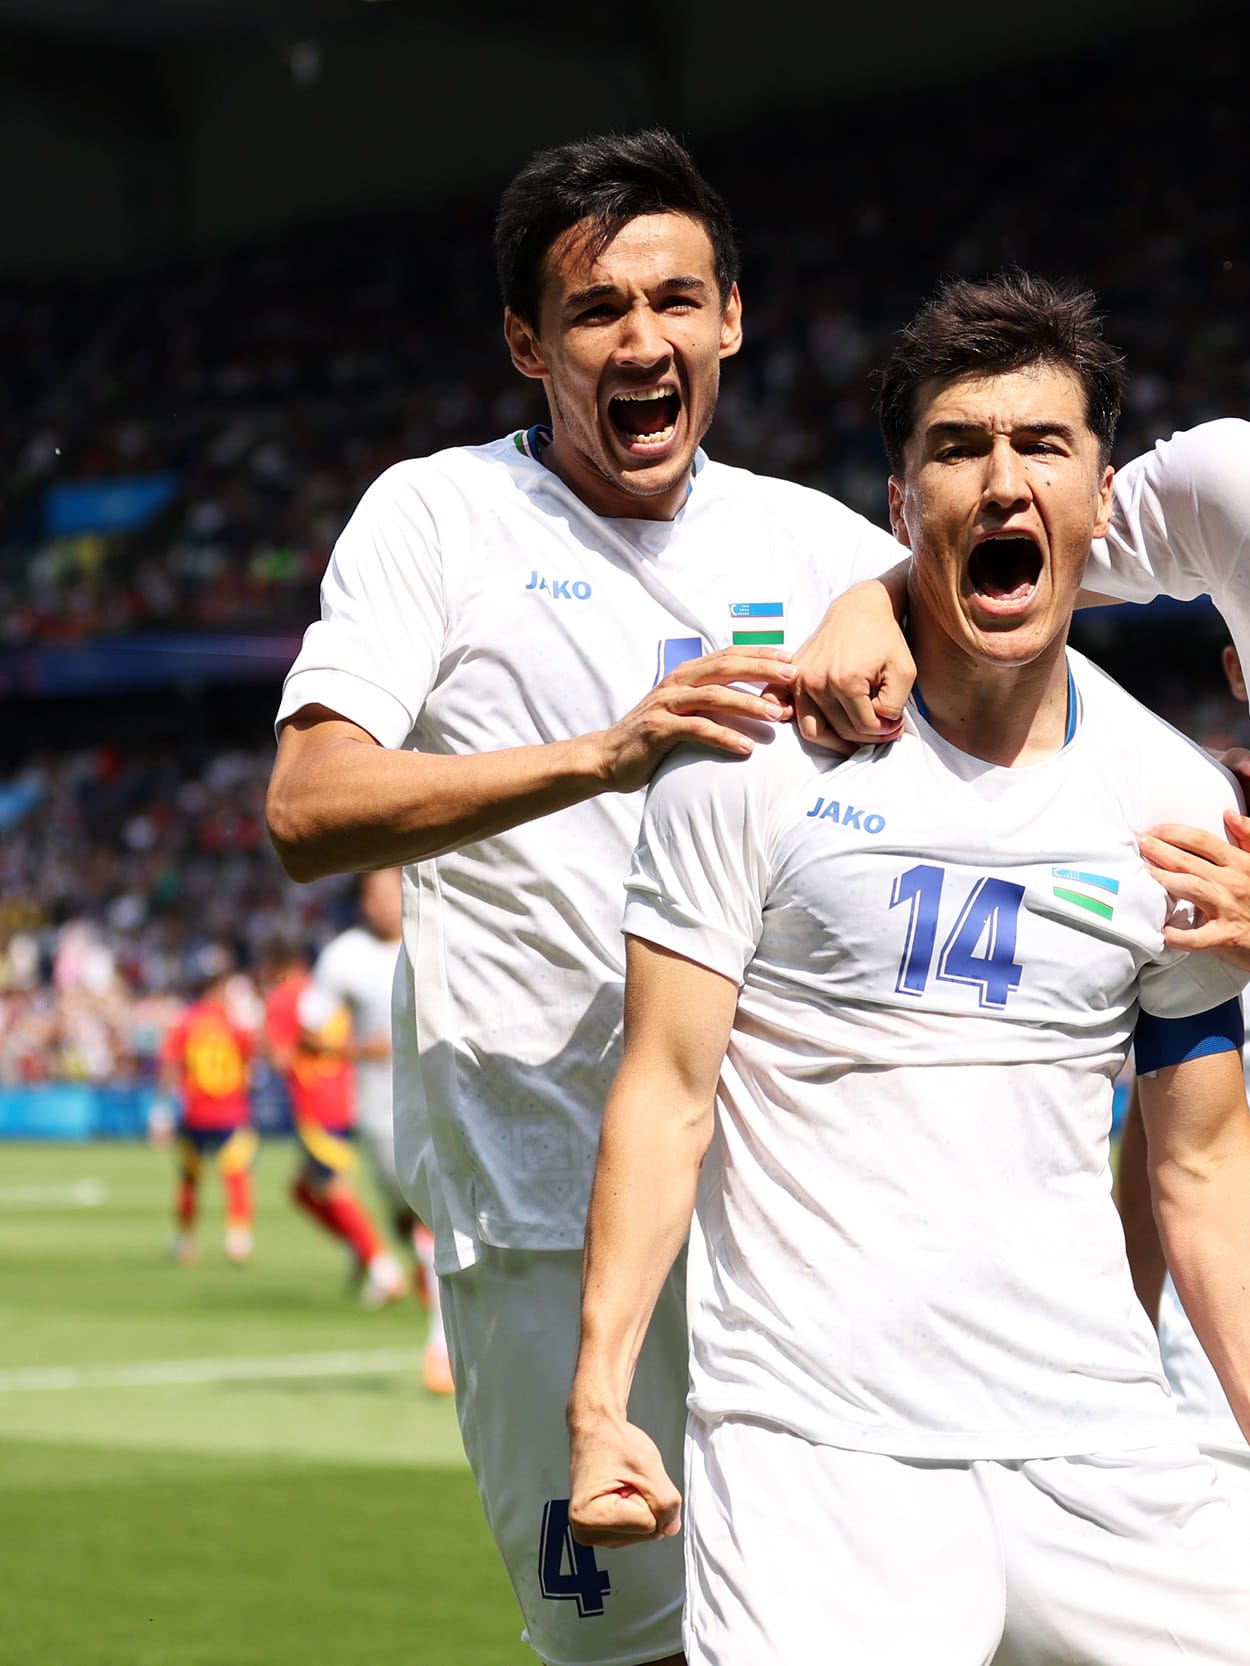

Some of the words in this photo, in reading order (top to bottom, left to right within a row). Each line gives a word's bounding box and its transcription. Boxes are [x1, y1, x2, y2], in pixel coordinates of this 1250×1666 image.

[807, 797, 886, 834] JAKO
[889, 864, 1025, 1011] 14
[538, 1499, 611, 1618] 4
